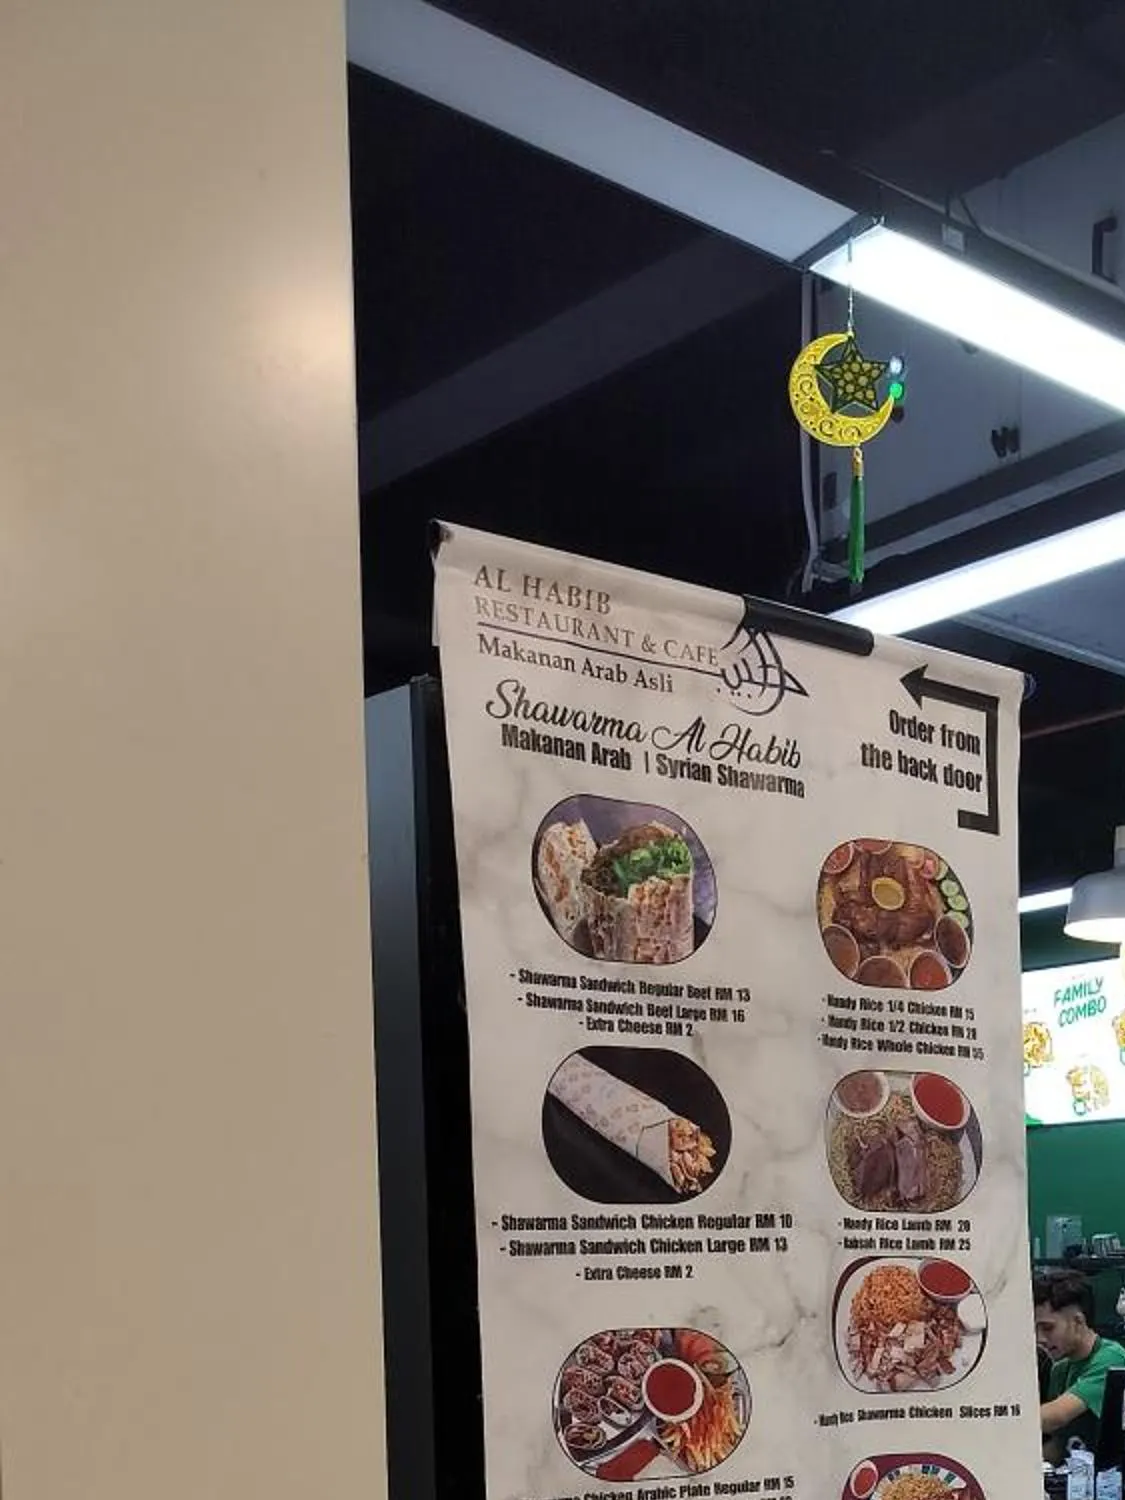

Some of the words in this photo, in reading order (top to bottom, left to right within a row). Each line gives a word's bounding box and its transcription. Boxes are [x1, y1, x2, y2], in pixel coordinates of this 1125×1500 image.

[474, 565, 511, 592] AL
[523, 574, 611, 615] HABIB
[475, 596, 635, 647] RESTAURANT
[642, 634, 656, 654] &
[664, 640, 719, 666] CAFE
[478, 632, 576, 674] Makanan
[581, 652, 628, 686] Arab
[634, 669, 673, 692] Asli
[485, 679, 644, 744] Shawarma
[651, 716, 706, 754] Al
[709, 723, 801, 769] Habib
[889, 709, 935, 744] Order
[940, 724, 981, 755] from
[502, 724, 586, 762] Makanan
[592, 742, 631, 770] Arab
[656, 753, 712, 783] Syrian
[717, 763, 805, 798] Shawarma
[861, 743, 892, 770] the
[898, 749, 938, 784] back
[944, 764, 982, 792] door
[519, 969, 577, 989] Shawarma
[580, 975, 635, 994] Sandwich
[640, 980, 683, 997] Regular
[687, 984, 711, 1000] Beef
[715, 987, 733, 1001] RM
[1053, 976, 1104, 1007] FAMILY
[526, 992, 583, 1012] Shawarma
[586, 998, 643, 1016] Sandwich
[648, 1003, 672, 1018] Beef
[676, 1005, 706, 1022] Large
[908, 1001, 947, 1016] Chicken
[1058, 997, 1106, 1028] COMBO
[587, 1017, 613, 1032] Extra
[618, 1019, 662, 1035] Cheese
[666, 1022, 683, 1036] RM
[686, 1023, 693, 1037] 2
[909, 1021, 948, 1036] Chicken
[878, 1039, 912, 1053] Whole
[916, 1042, 955, 1056] Chicken
[502, 1215, 567, 1231] Shawarma
[571, 1215, 636, 1230] Sandwich
[641, 1214, 693, 1230] Chicken
[698, 1214, 750, 1231] Regular
[756, 1214, 775, 1228] RM
[780, 1214, 793, 1228] 10
[903, 1218, 932, 1230] Lamb
[509, 1240, 575, 1256] Shawarma
[580, 1239, 646, 1255] Sandwich
[650, 1238, 703, 1254] Chicken
[707, 1238, 746, 1254] Large
[750, 1238, 770, 1252] RM
[906, 1237, 935, 1250] Lamb
[584, 1267, 612, 1280] Extra
[617, 1266, 660, 1280] Cheese
[664, 1265, 681, 1279] RM
[685, 1265, 693, 1278] 2
[909, 1406, 952, 1419] Chicken
[959, 1405, 991, 1418] Slices
[680, 1485, 710, 1500] Plate
[714, 1480, 760, 1496] Regular
